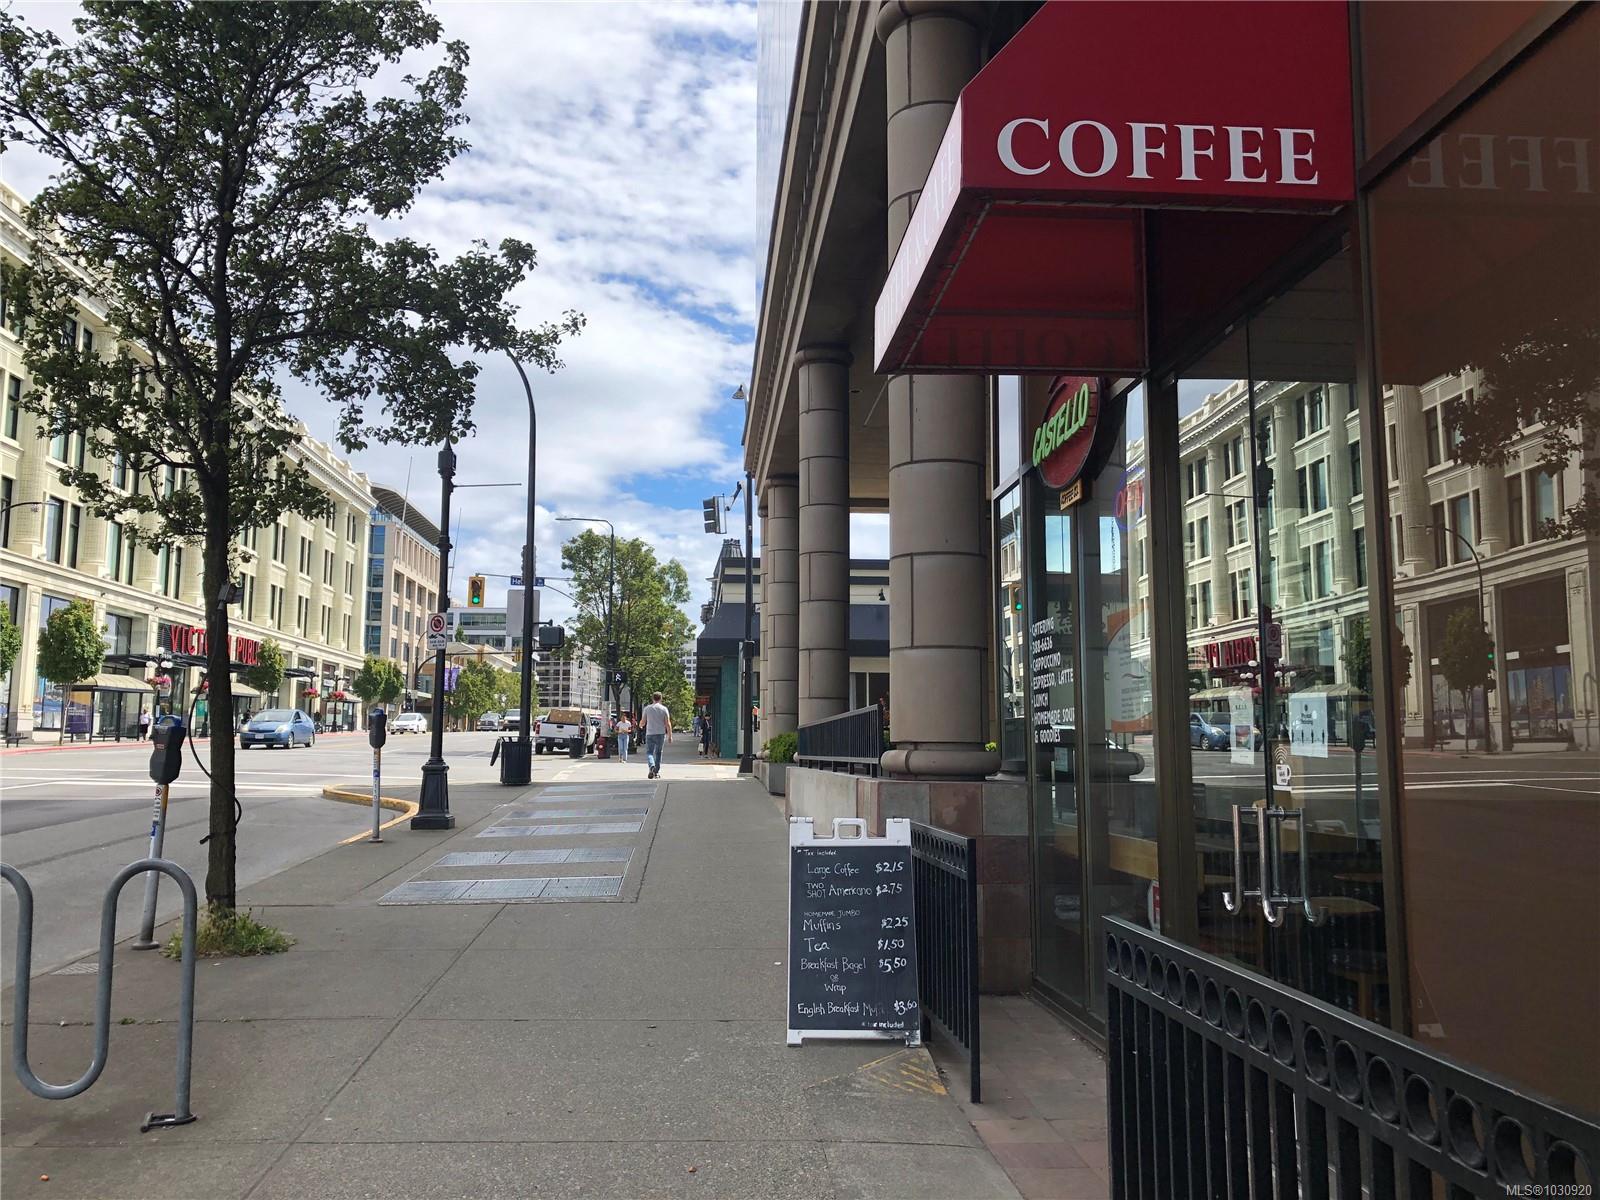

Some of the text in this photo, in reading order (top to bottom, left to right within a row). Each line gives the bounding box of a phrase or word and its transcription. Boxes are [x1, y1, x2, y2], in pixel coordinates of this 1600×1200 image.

[997, 117, 1319, 185] COFFEE
[1032, 382, 1089, 467] CASTELLO
[1032, 616, 1054, 637] CATERING
[1058, 667, 1074, 685] LATTE
[1033, 692, 1049, 707] LUNCH
[1039, 728, 1061, 743] GOODIES
[807, 861, 904, 880] Large Coffee $2.15
[806, 882, 825, 890] TWO
[806, 888, 826, 899] SHOT
[828, 882, 903, 897] Americano $2.75
[838, 909, 861, 919] JUMBO
[802, 916, 909, 933] Muffins $2.25
[803, 937, 905, 953] Tea $1.50
[800, 956, 907, 974] Breakfast Bagel $5.50
[824, 983, 847, 995] Wrap
[797, 1002, 826, 1018] English
[827, 1001, 860, 1017] Breakfast
[893, 999, 918, 1016] $3.60
